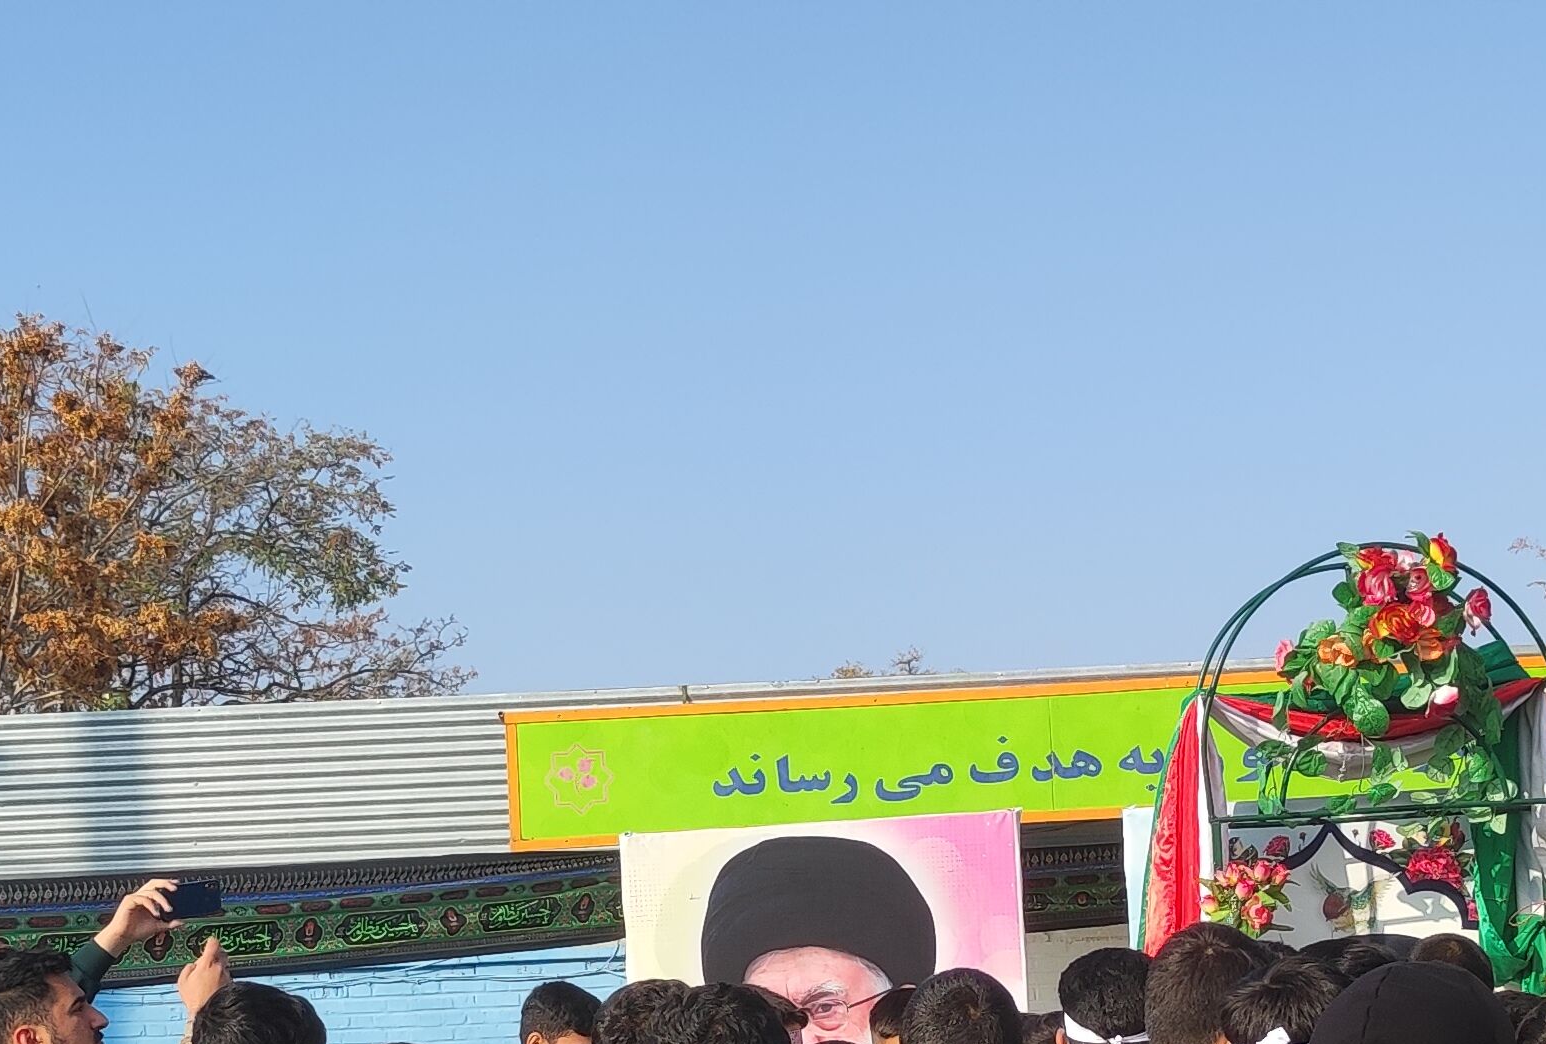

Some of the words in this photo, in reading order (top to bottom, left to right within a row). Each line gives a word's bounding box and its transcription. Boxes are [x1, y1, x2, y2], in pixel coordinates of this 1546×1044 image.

[874, 762, 954, 803] می
[969, 735, 1103, 784] هدف
[1118, 744, 1168, 792] به
